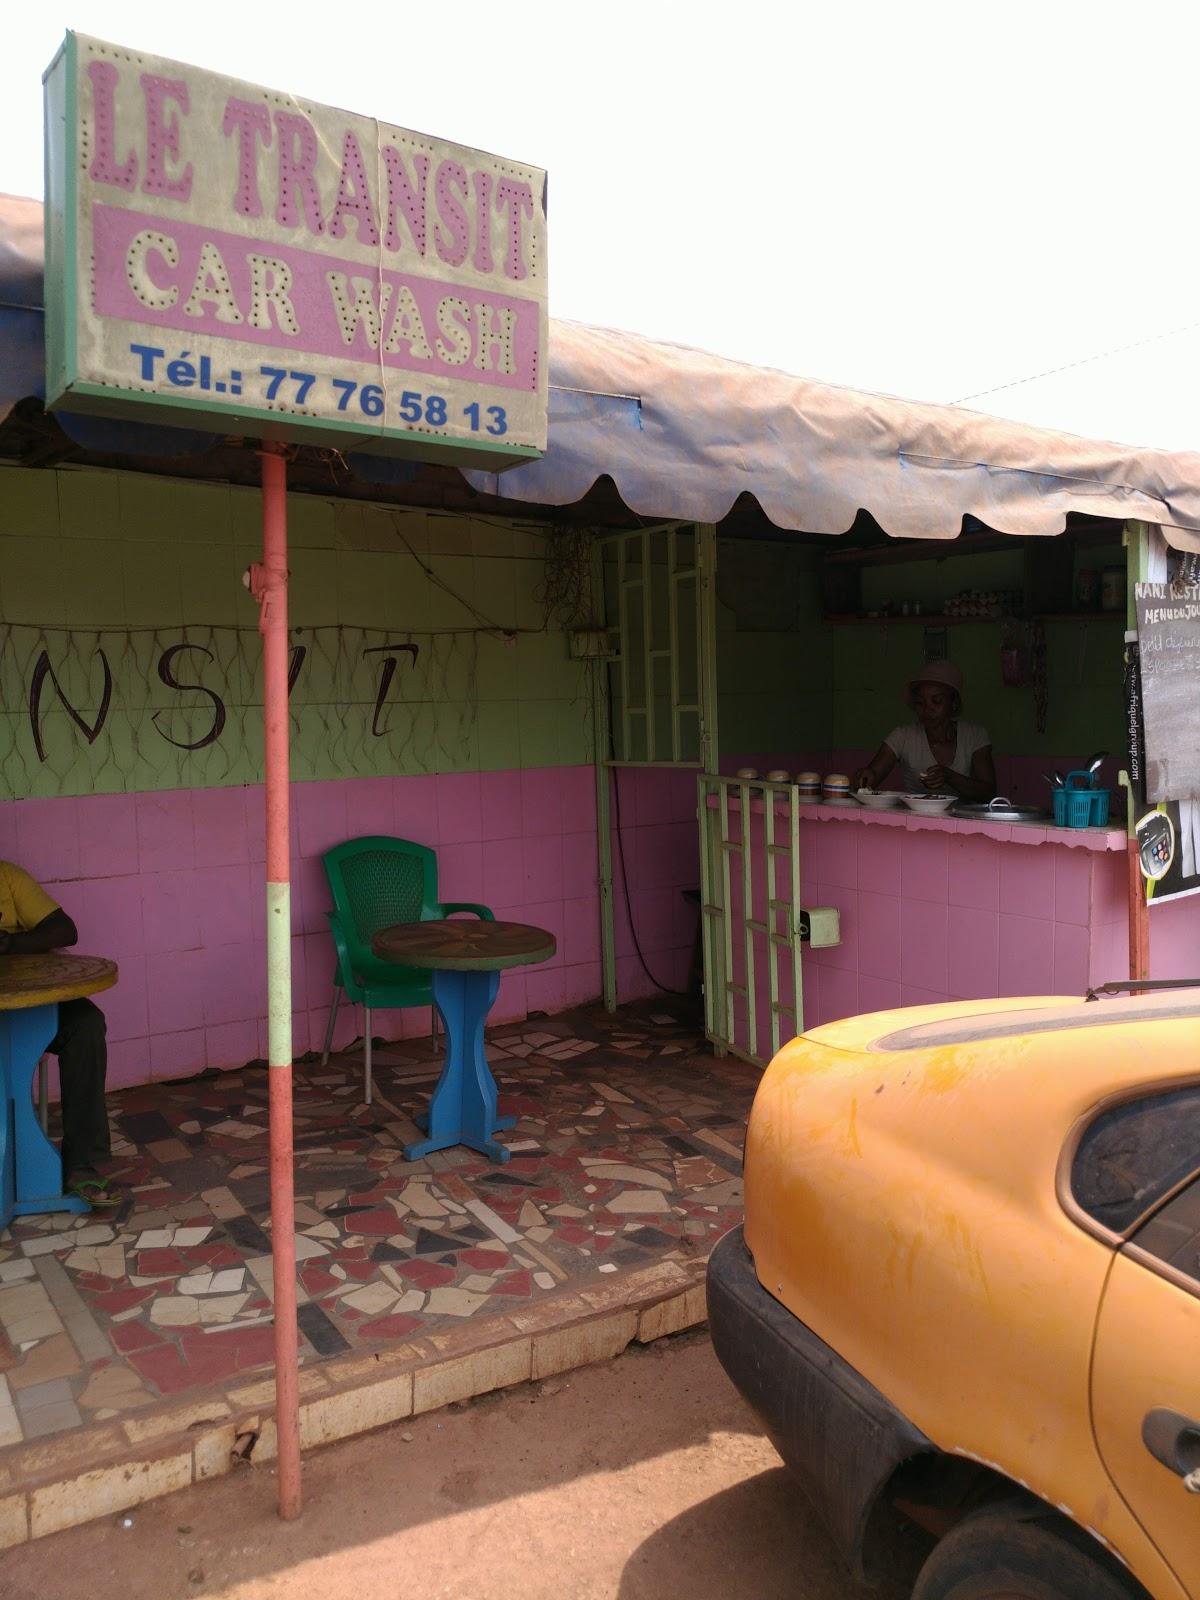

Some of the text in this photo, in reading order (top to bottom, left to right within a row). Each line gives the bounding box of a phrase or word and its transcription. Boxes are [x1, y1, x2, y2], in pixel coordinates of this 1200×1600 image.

[87, 60, 534, 281] LE TRANSIT
[125, 229, 519, 376] CAR WASH
[260, 366, 316, 402] 77
[332, 377, 385, 417] 76
[400, 391, 447, 426] 58
[463, 402, 508, 436] 13
